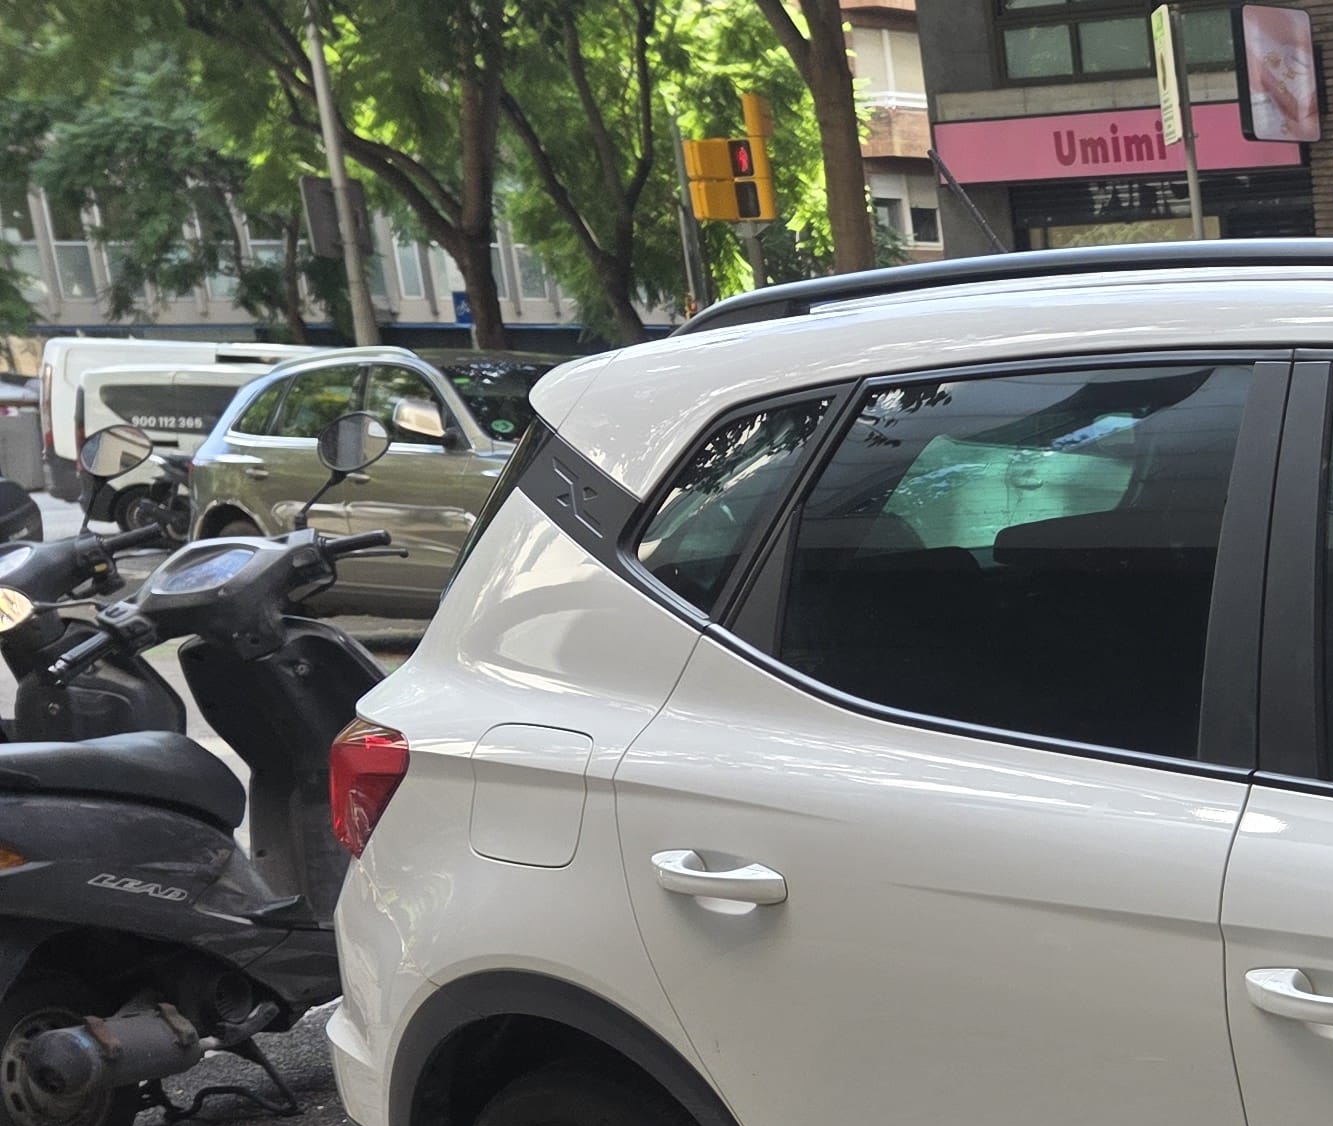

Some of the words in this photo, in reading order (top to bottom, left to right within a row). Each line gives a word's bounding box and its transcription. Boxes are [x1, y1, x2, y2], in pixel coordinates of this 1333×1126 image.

[1053, 120, 1167, 167] Umimi
[131, 415, 156, 428] 900
[158, 416, 177, 428] 112
[87, 873, 188, 901] LEAD
